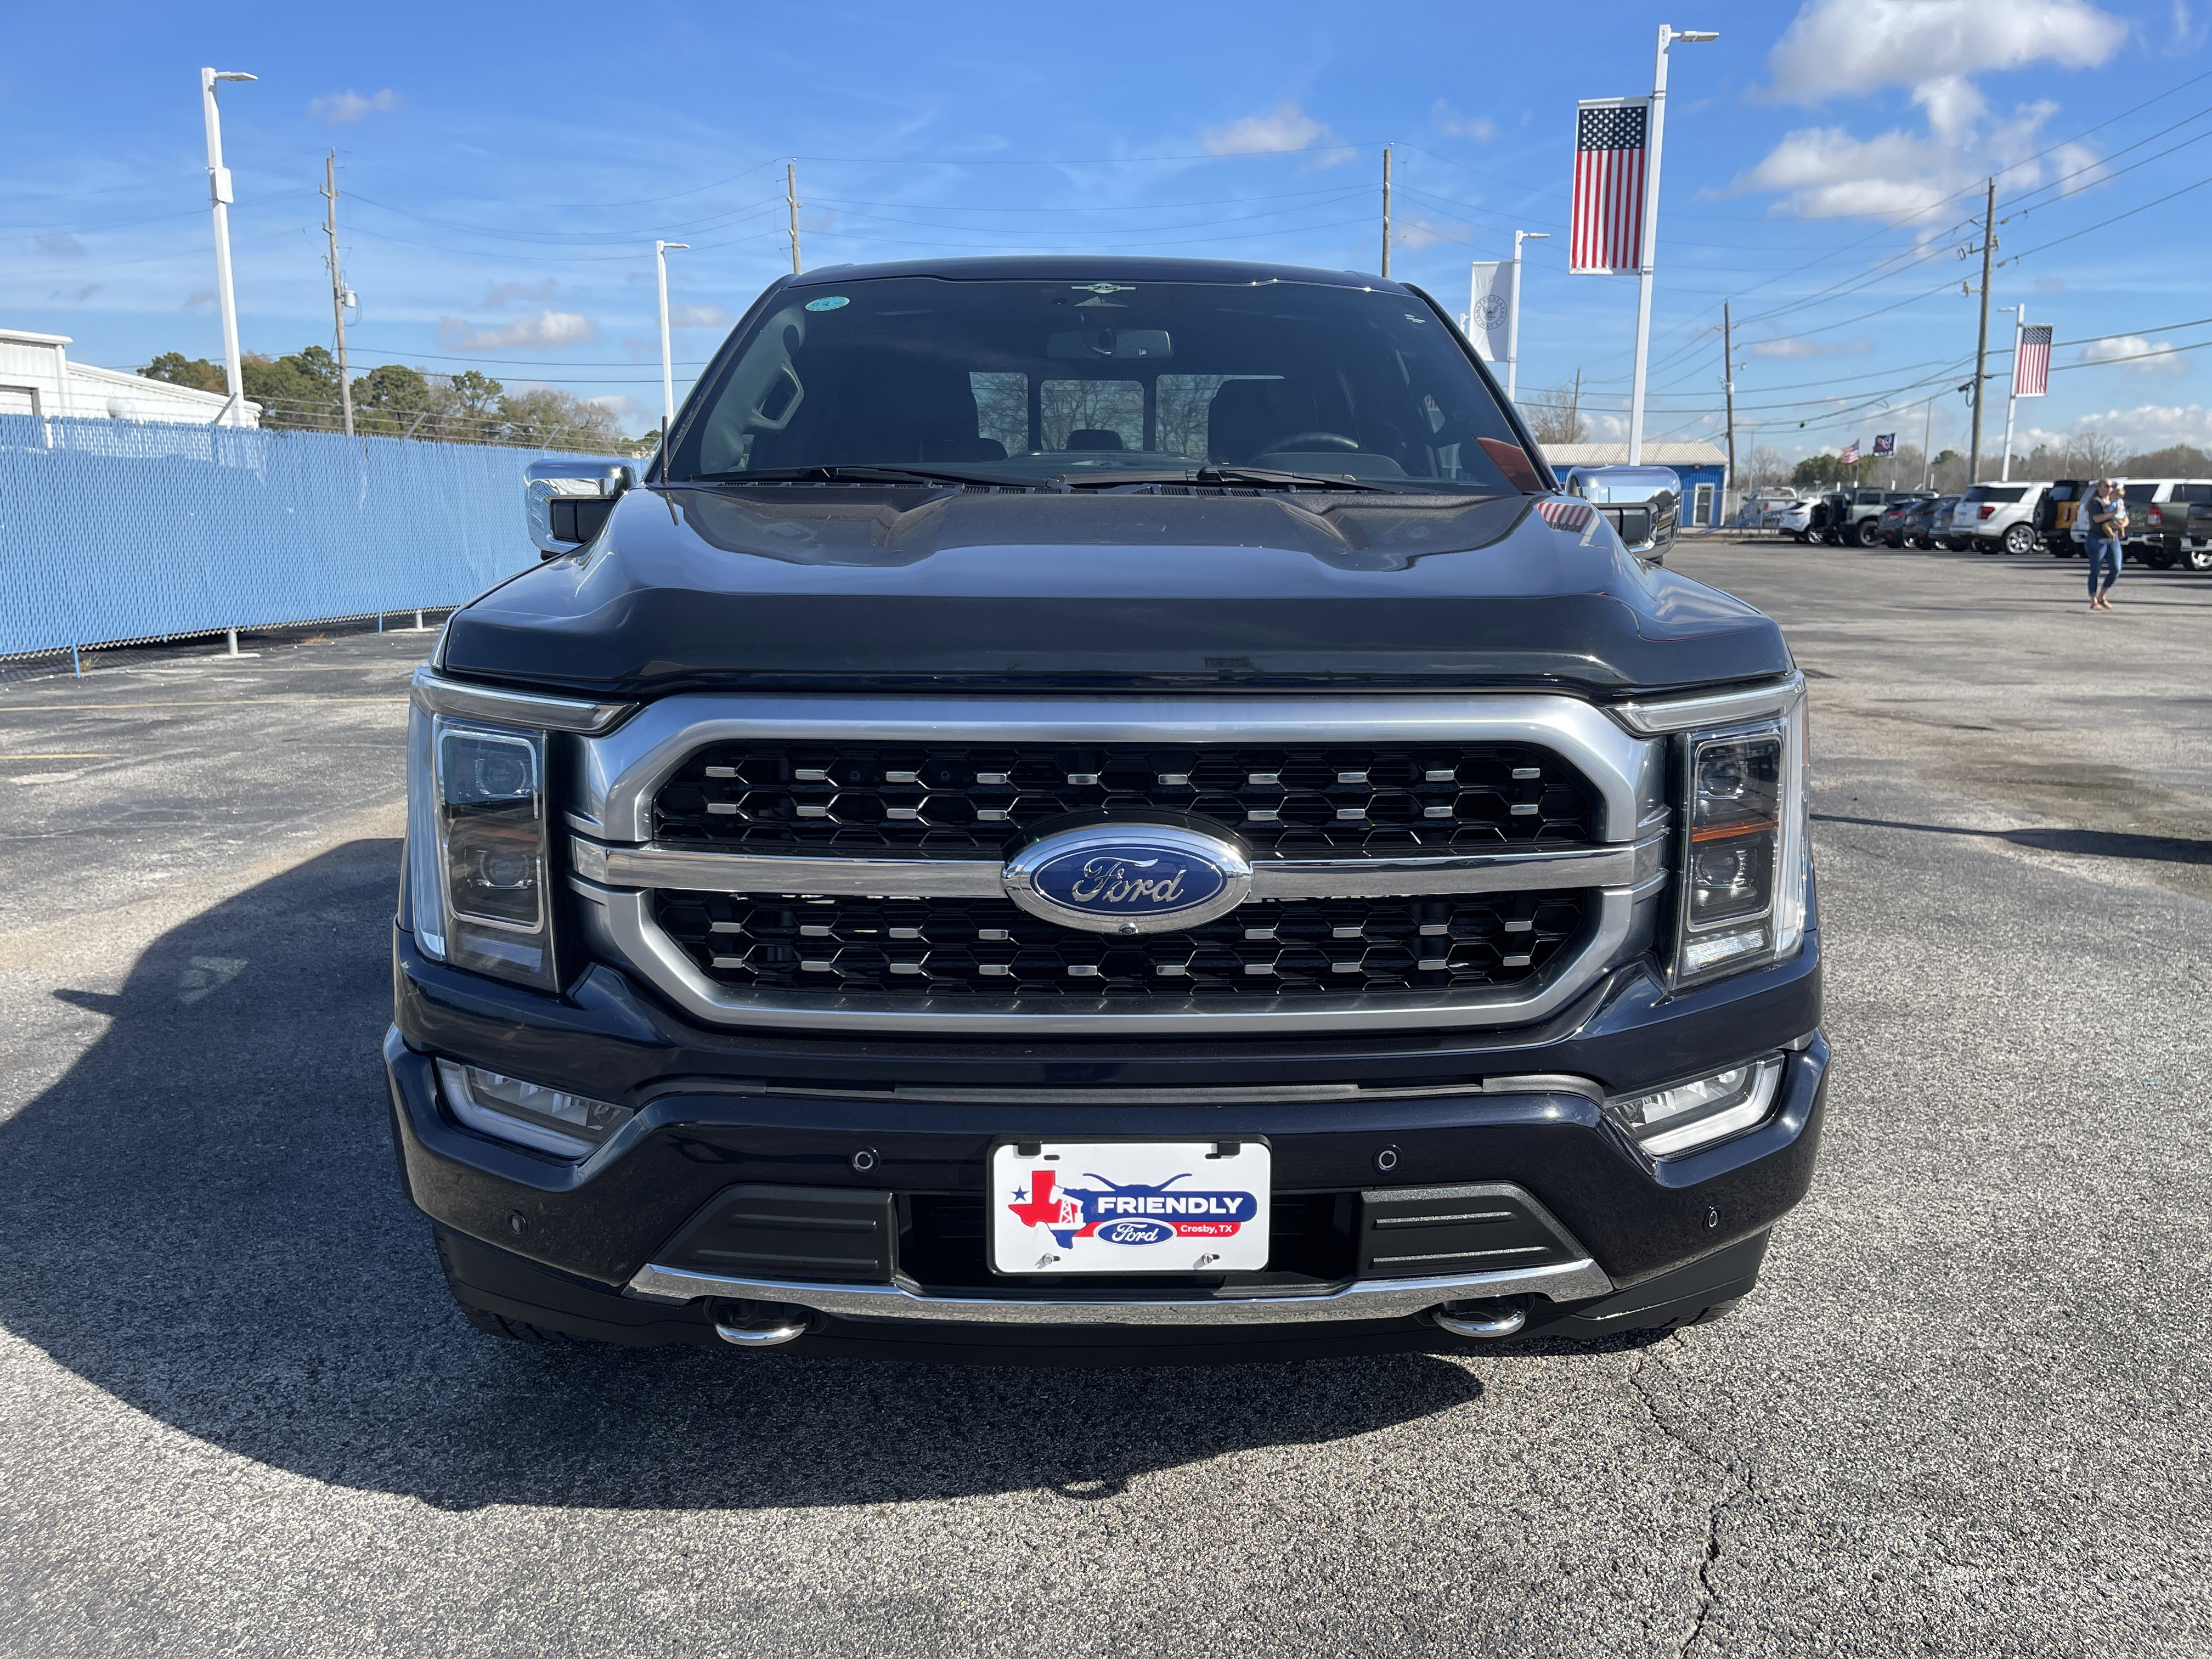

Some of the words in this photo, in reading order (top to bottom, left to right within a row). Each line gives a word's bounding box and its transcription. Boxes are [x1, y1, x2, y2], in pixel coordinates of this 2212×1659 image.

[1072, 857, 1187, 902] Ford
[1098, 1197, 1243, 1214] FRIENDLY
[1111, 1223, 1159, 1242] Ford
[1181, 1224, 1217, 1234] Crosby,
